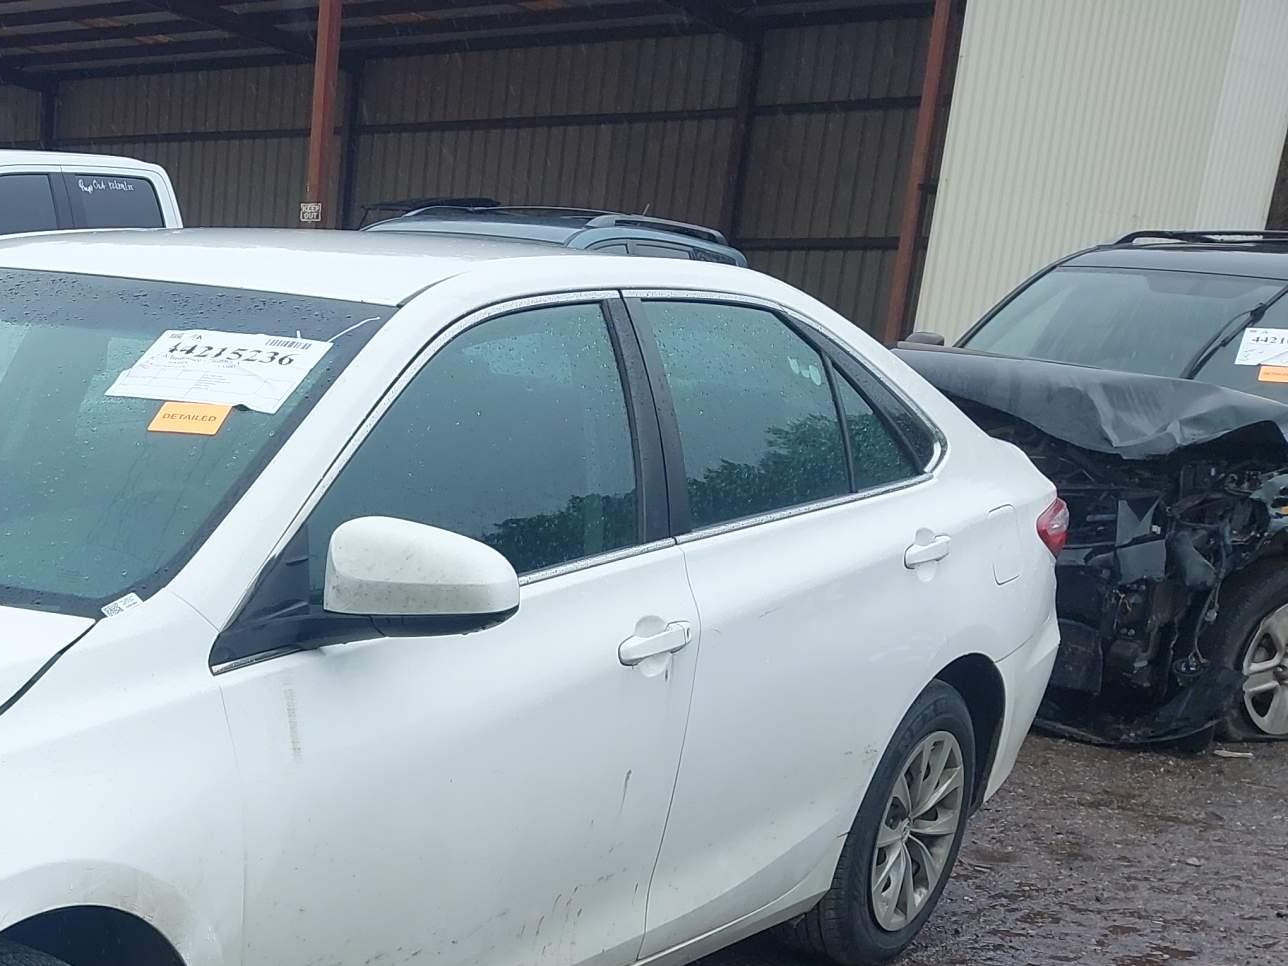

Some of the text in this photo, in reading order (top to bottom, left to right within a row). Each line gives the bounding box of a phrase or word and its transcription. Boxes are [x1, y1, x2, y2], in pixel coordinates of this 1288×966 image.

[1251, 336, 1288, 345] 4421
[168, 342, 296, 366] 44215236
[161, 412, 217, 423] DETAILED
